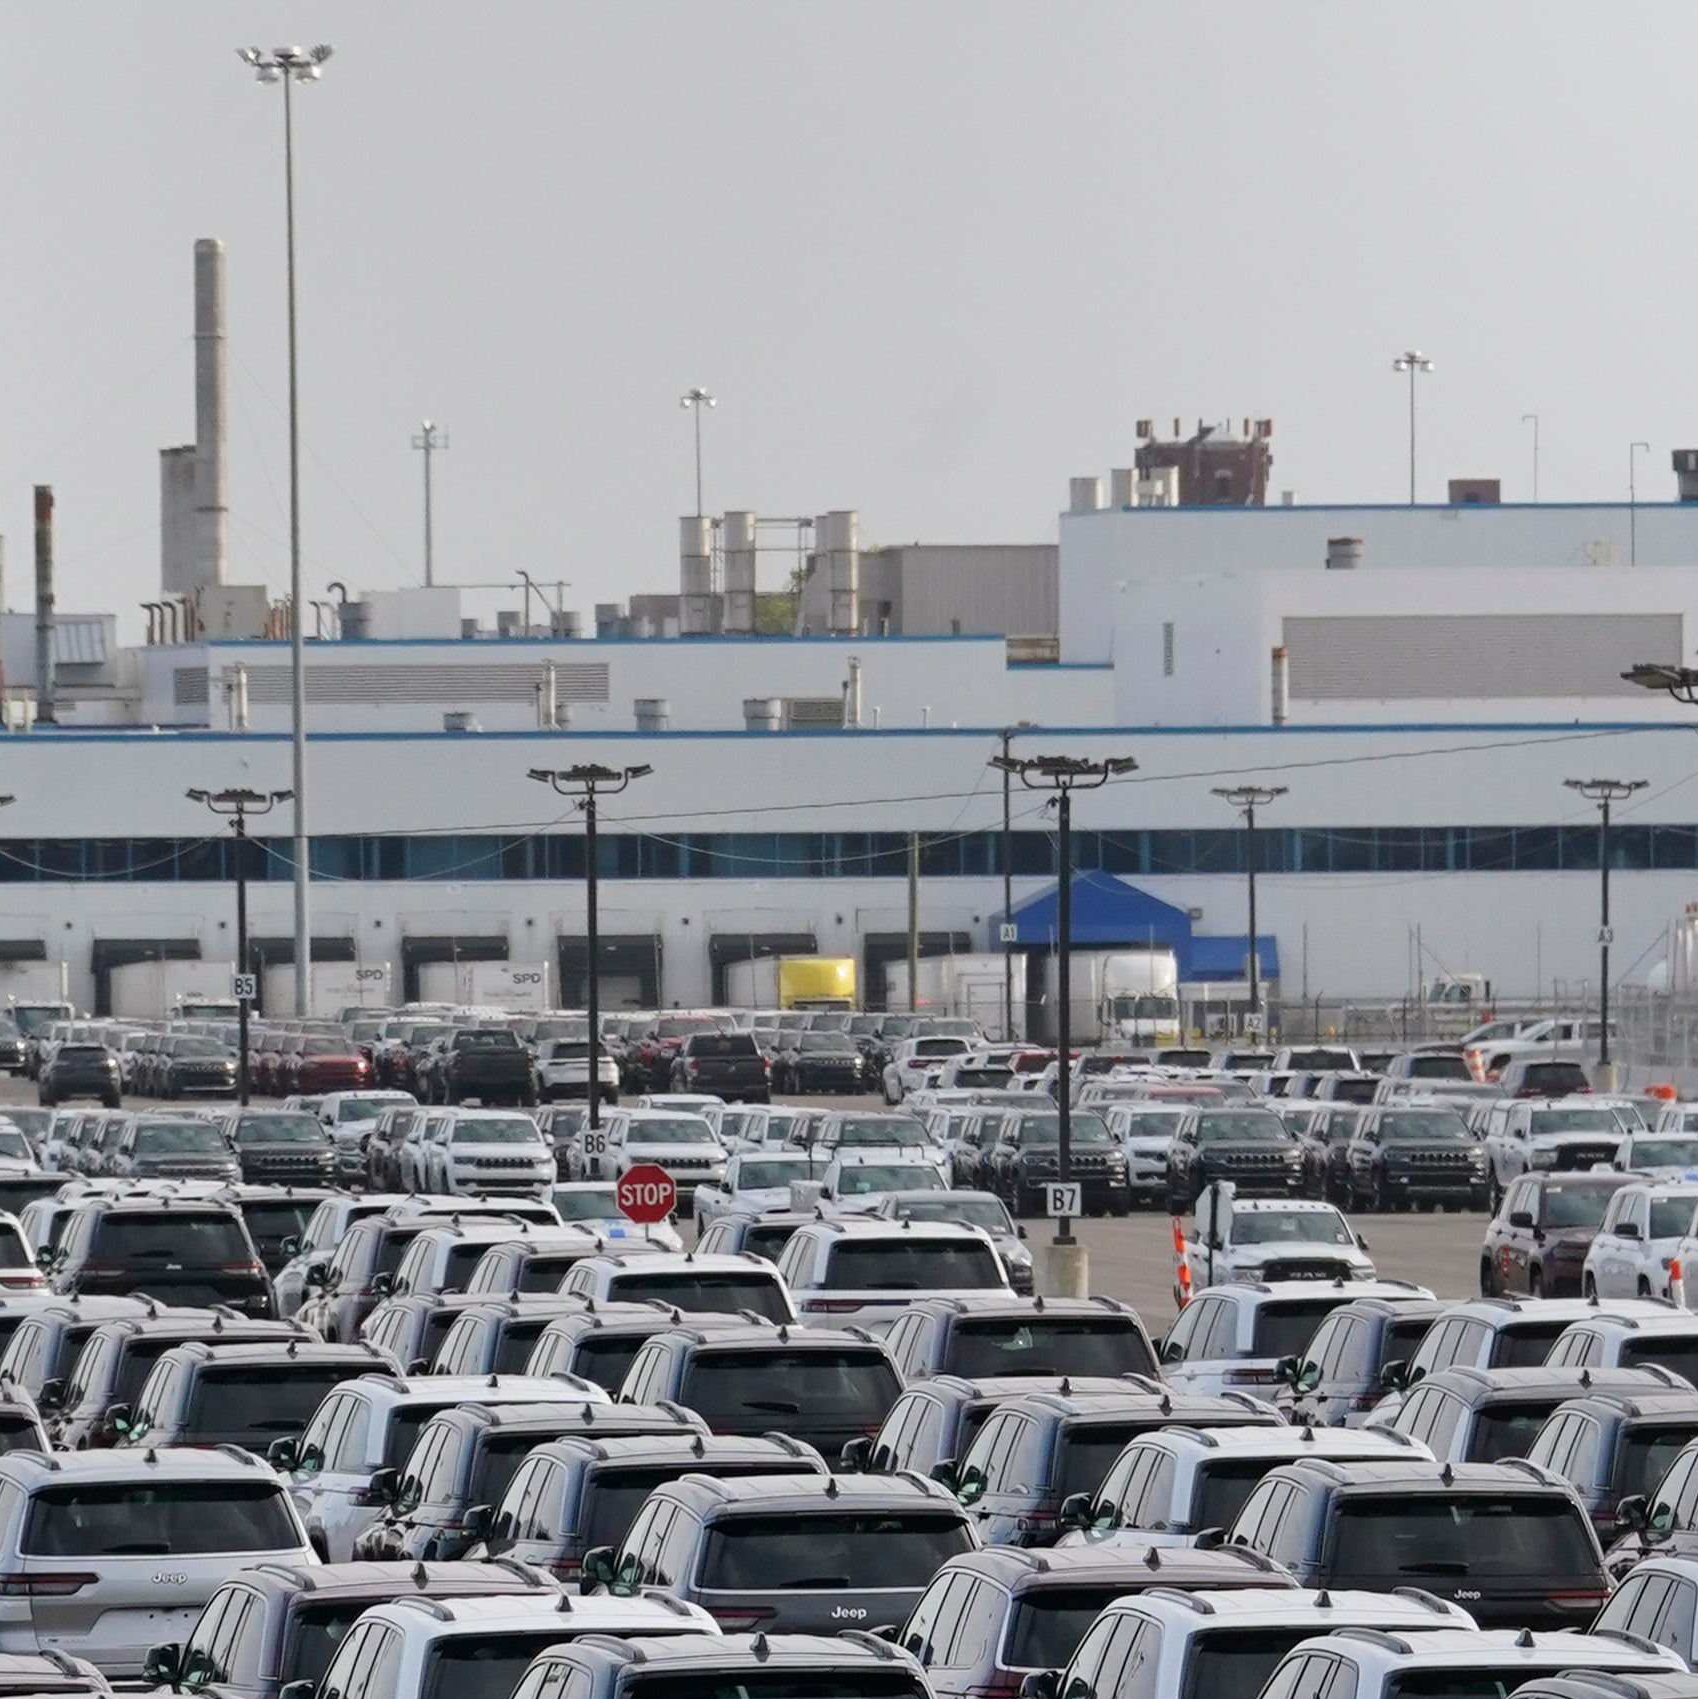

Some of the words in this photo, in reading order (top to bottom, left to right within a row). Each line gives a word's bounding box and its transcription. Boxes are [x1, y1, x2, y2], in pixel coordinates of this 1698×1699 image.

[1003, 927, 1015, 939] A1
[356, 970, 383, 981] SPD
[512, 973, 541, 984] SPD
[235, 978, 252, 995] B5
[1247, 1016, 1261, 1030] A2
[585, 1134, 605, 1153] B6
[621, 1183, 672, 1207] STOP
[1053, 1189, 1076, 1211] B7
[152, 1572, 187, 1585] Jeep
[1454, 1590, 1480, 1600] Jeep
[831, 1606, 867, 1619] Jeep
